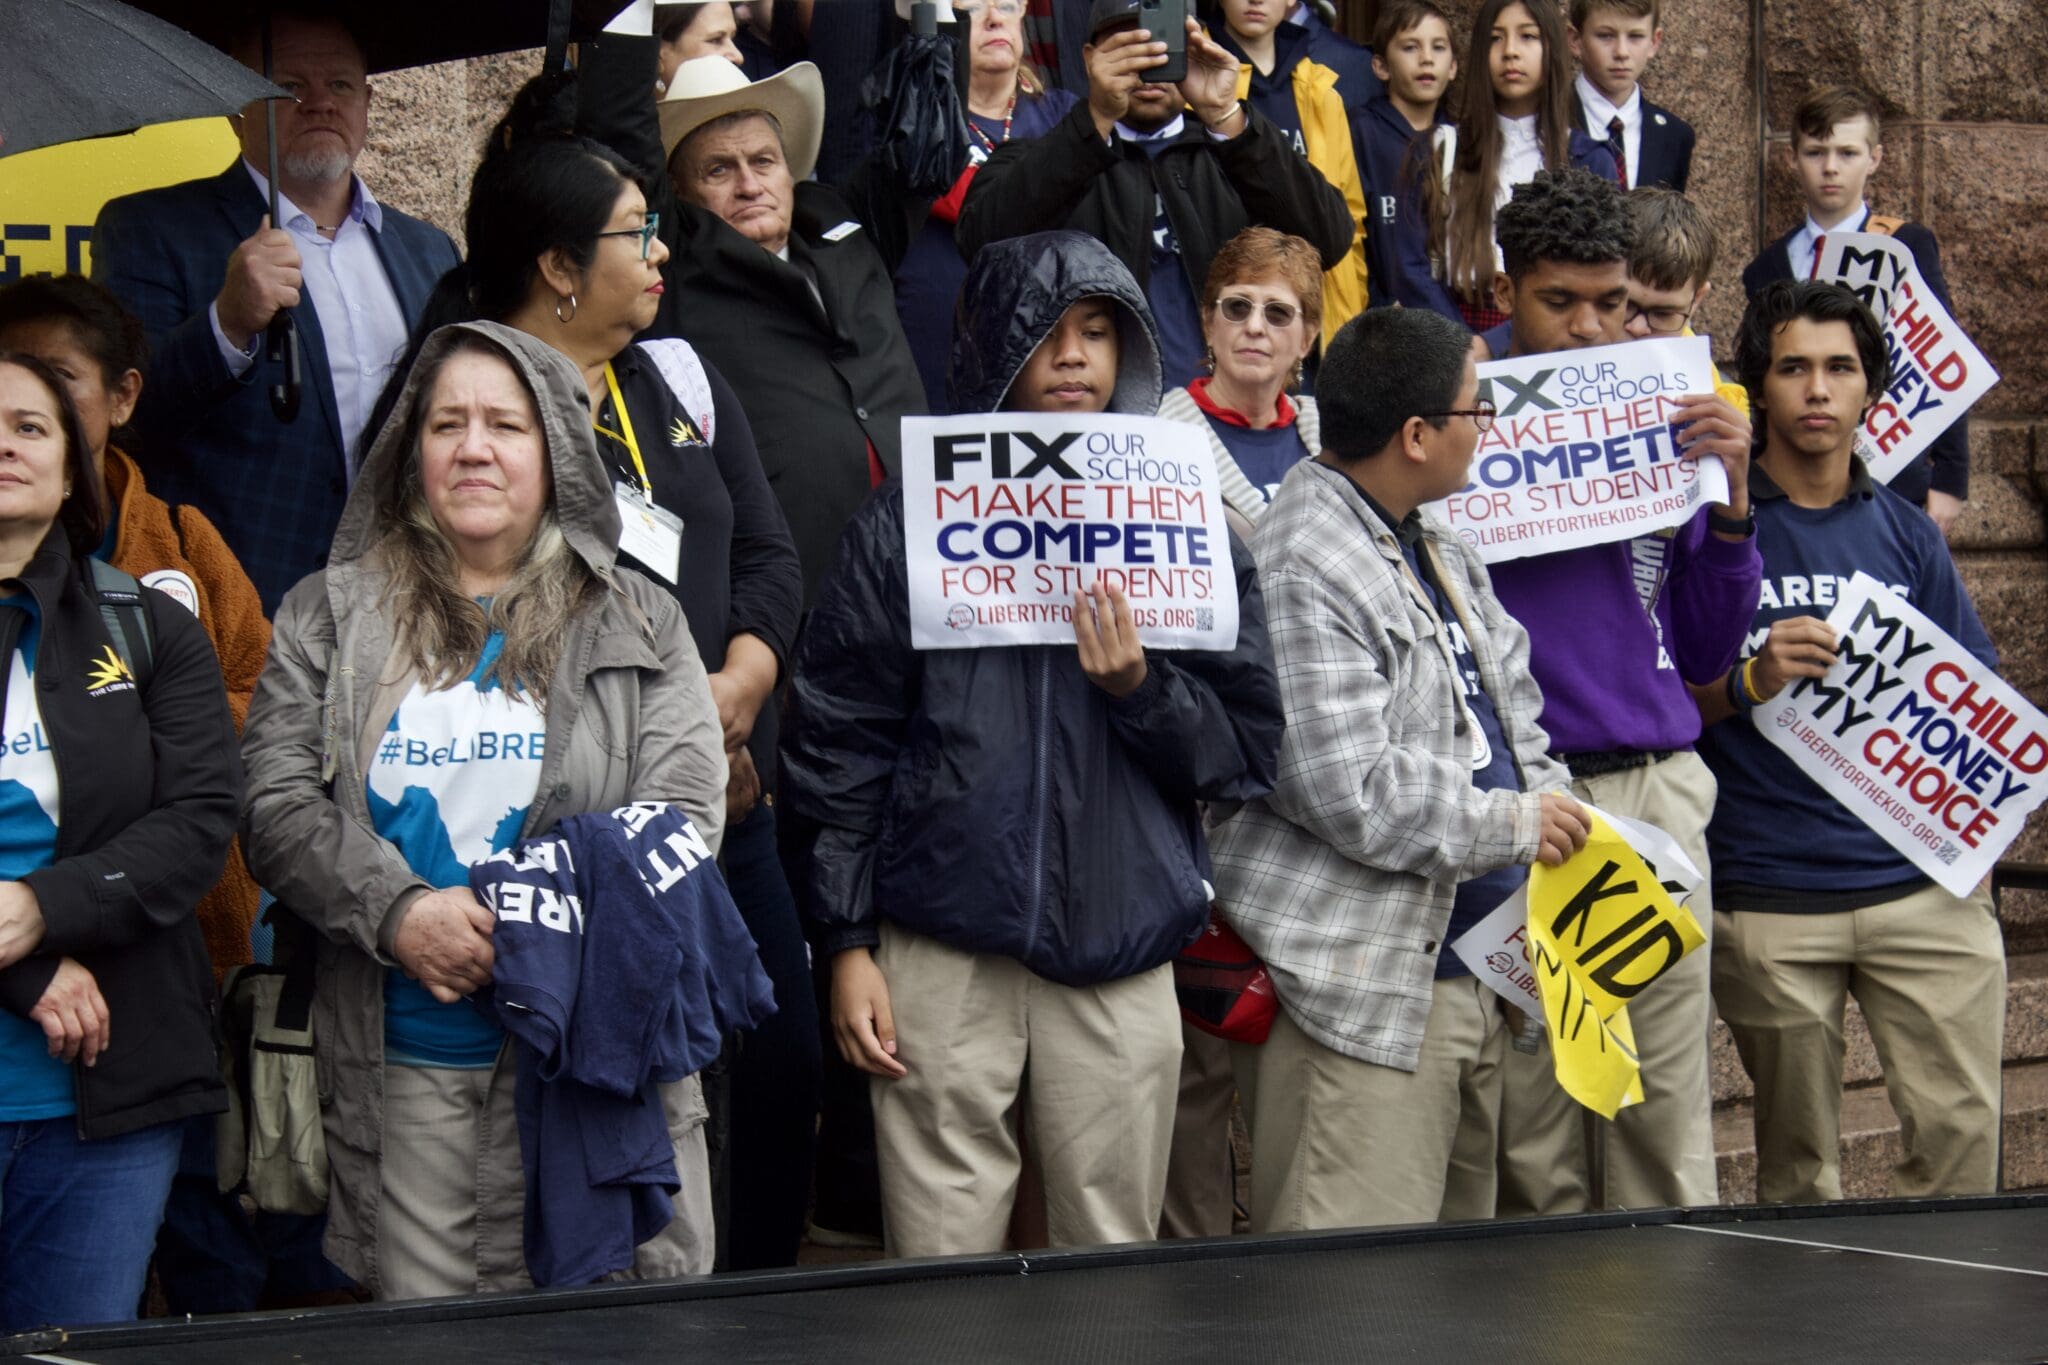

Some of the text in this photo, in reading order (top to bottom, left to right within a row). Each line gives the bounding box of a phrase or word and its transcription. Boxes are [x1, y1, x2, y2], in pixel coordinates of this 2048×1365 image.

[1838, 246, 1907, 292] MY
[1477, 367, 1562, 417] IX
[1559, 361, 1617, 387] OUR
[1563, 373, 1689, 408] SCHOOLS
[933, 431, 1086, 482] FIX
[1087, 432, 1145, 456] OUR
[1459, 420, 1697, 493] OMPETE
[1478, 414, 1569, 453] AKE
[1087, 458, 1202, 487] SCHOOLS
[1447, 456, 1699, 524] FOR STUDENTS!
[935, 484, 1207, 523] MAKE THEM
[1480, 495, 1686, 546] LIBERTYFORTHEKIDS.ORG
[936, 520, 1212, 566] COMPETE
[941, 565, 1214, 600] FOR STUDENTS!
[977, 604, 1195, 629] LIBERTYFODS.ORG
[1849, 597, 2048, 776] MY CHILD
[1833, 634, 2030, 809] MY MONEY
[1790, 678, 2000, 850] MY CHOICE
[1790, 719, 1943, 850] LIBERTYFORTHEKIDS.ORG
[1551, 859, 1684, 999] KID
[1506, 966, 1540, 1001] LIBE
